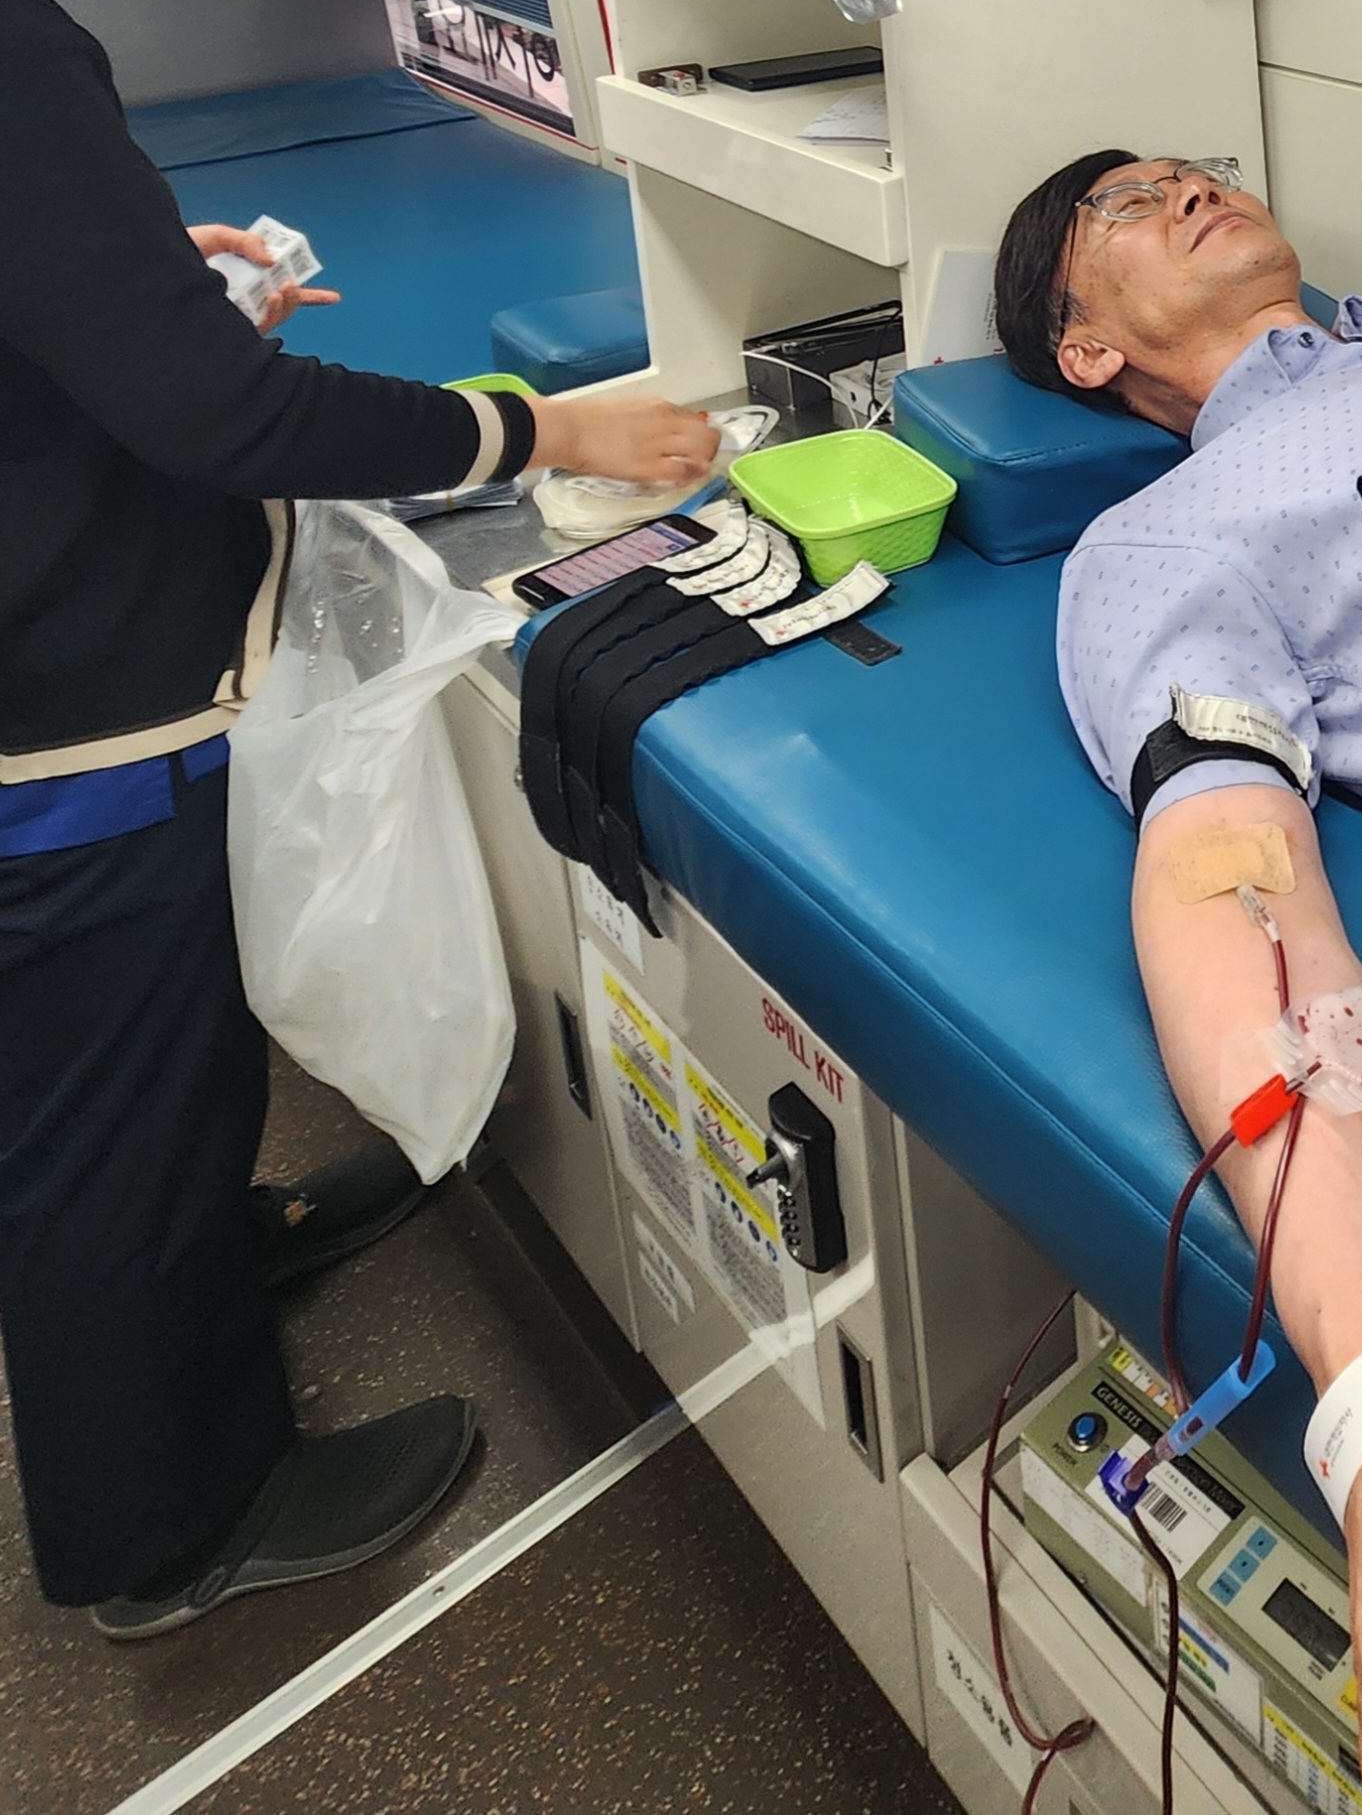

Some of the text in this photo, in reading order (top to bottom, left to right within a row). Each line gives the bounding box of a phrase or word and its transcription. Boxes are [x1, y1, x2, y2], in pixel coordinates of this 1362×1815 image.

[762, 998, 844, 1103] SPILL KIT
[1096, 1385, 1142, 1430] GENESIS
[1051, 1442, 1078, 1468] POWER
